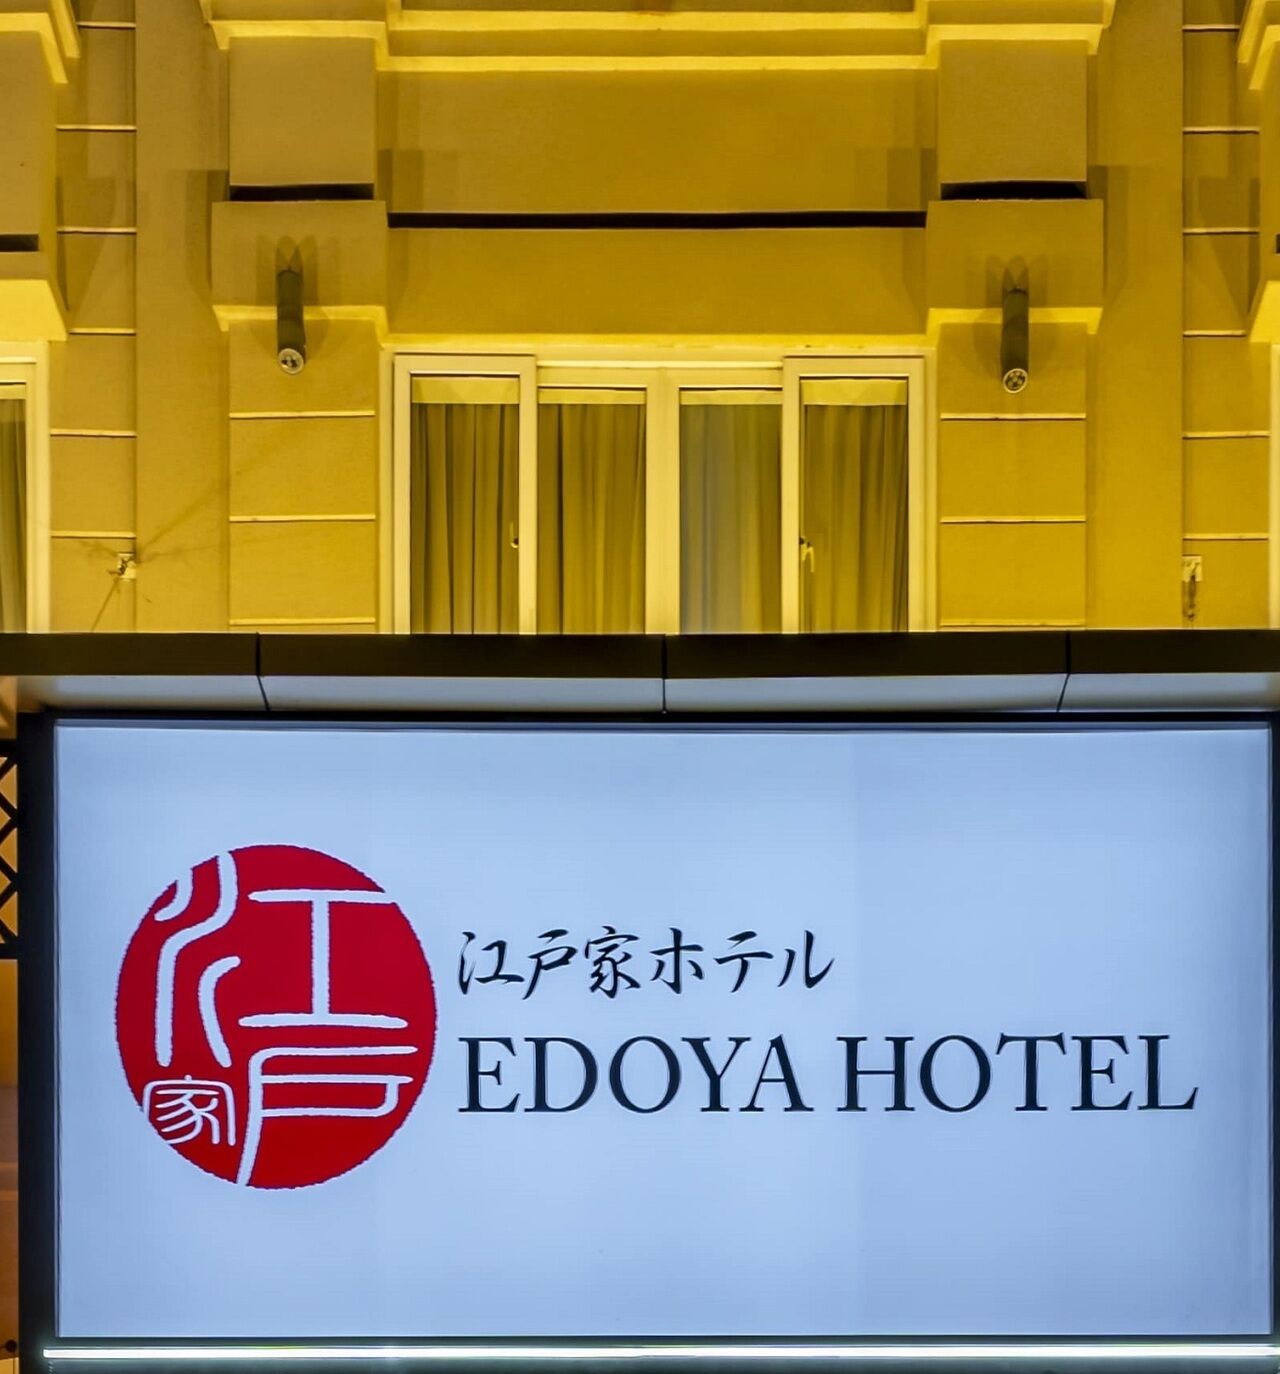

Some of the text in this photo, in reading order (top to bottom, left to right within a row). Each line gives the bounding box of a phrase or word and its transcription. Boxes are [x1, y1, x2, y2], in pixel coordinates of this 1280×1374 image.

[457, 924, 835, 1000] 江戸家ホテル
[458, 1033, 1199, 1114] EDOYA HOTEL
